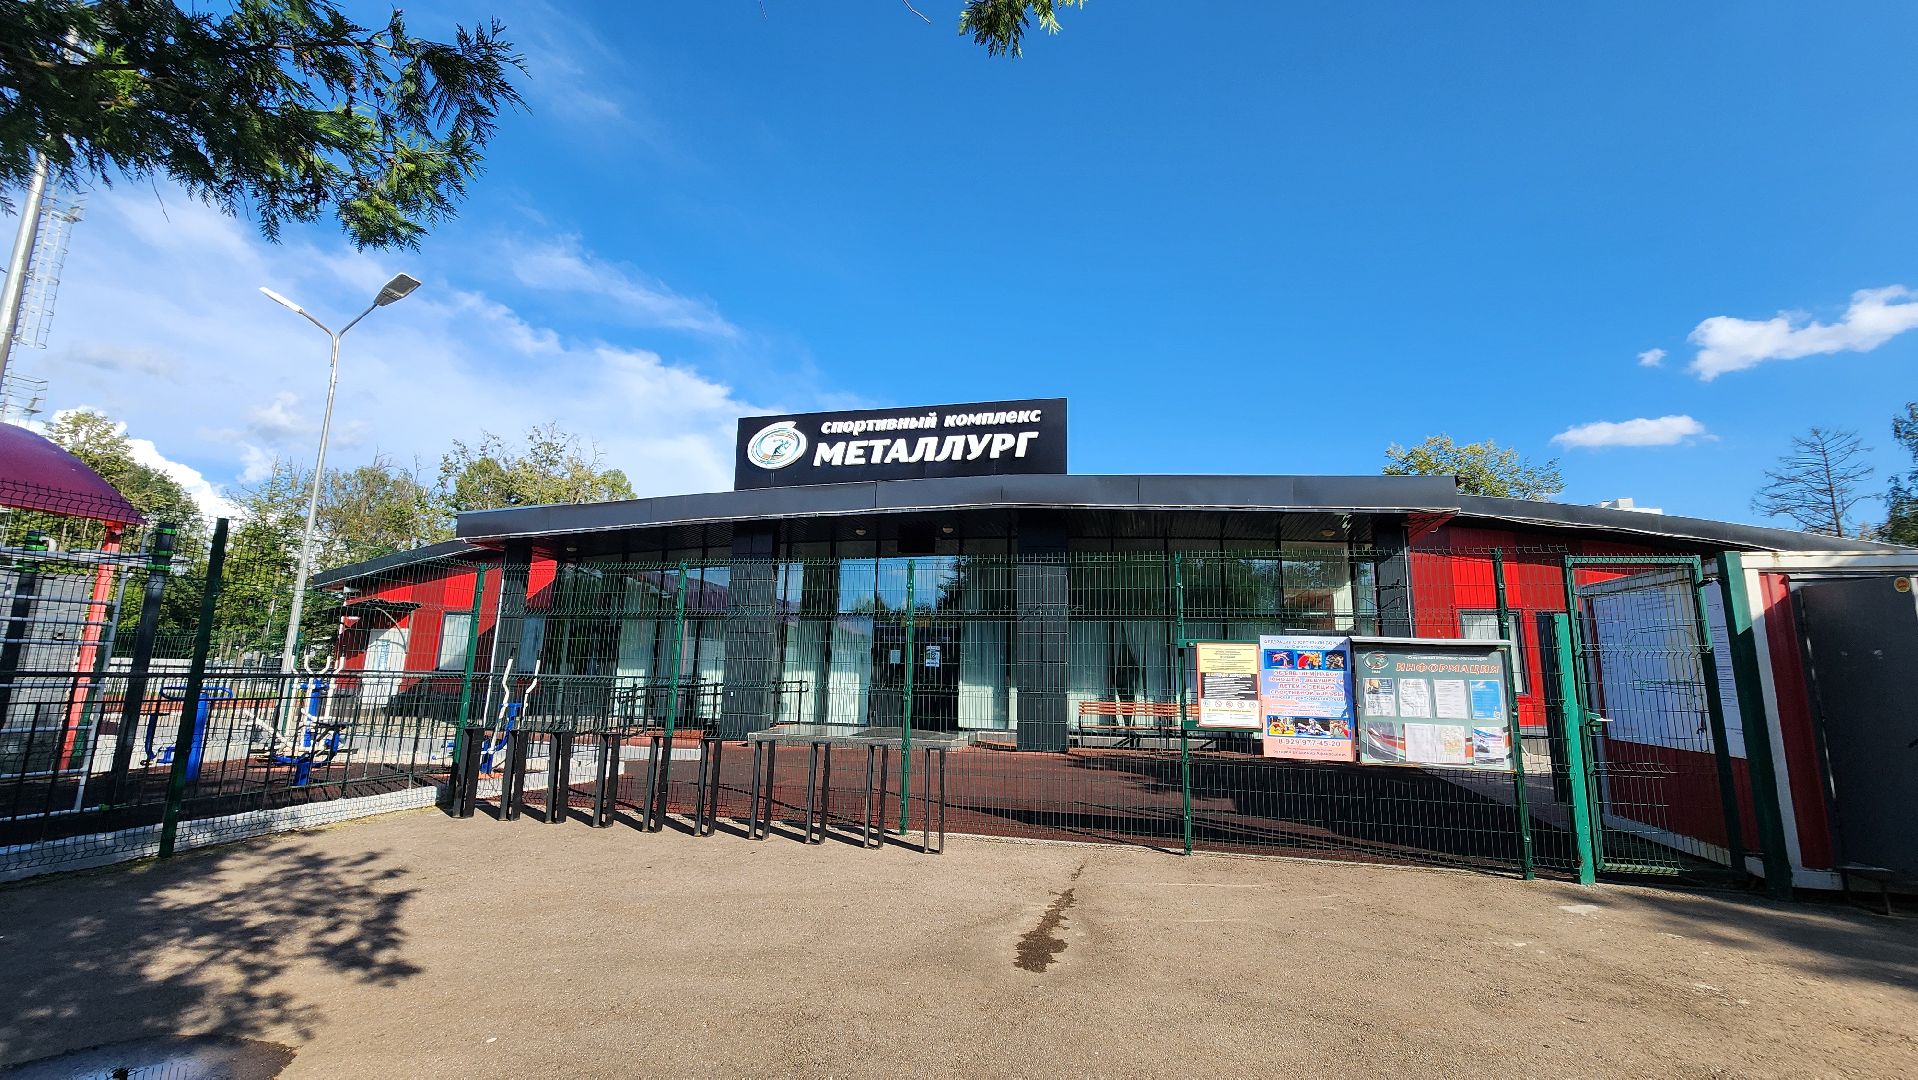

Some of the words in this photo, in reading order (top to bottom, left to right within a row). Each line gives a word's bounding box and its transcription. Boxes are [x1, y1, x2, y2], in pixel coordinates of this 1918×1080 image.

[820, 411, 937, 436] спортивный
[944, 408, 1042, 428] комплекс
[812, 430, 1040, 467] МЕТАЛЛУРГ
[1395, 662, 1500, 675] ИНФОРМАЦИЯ
